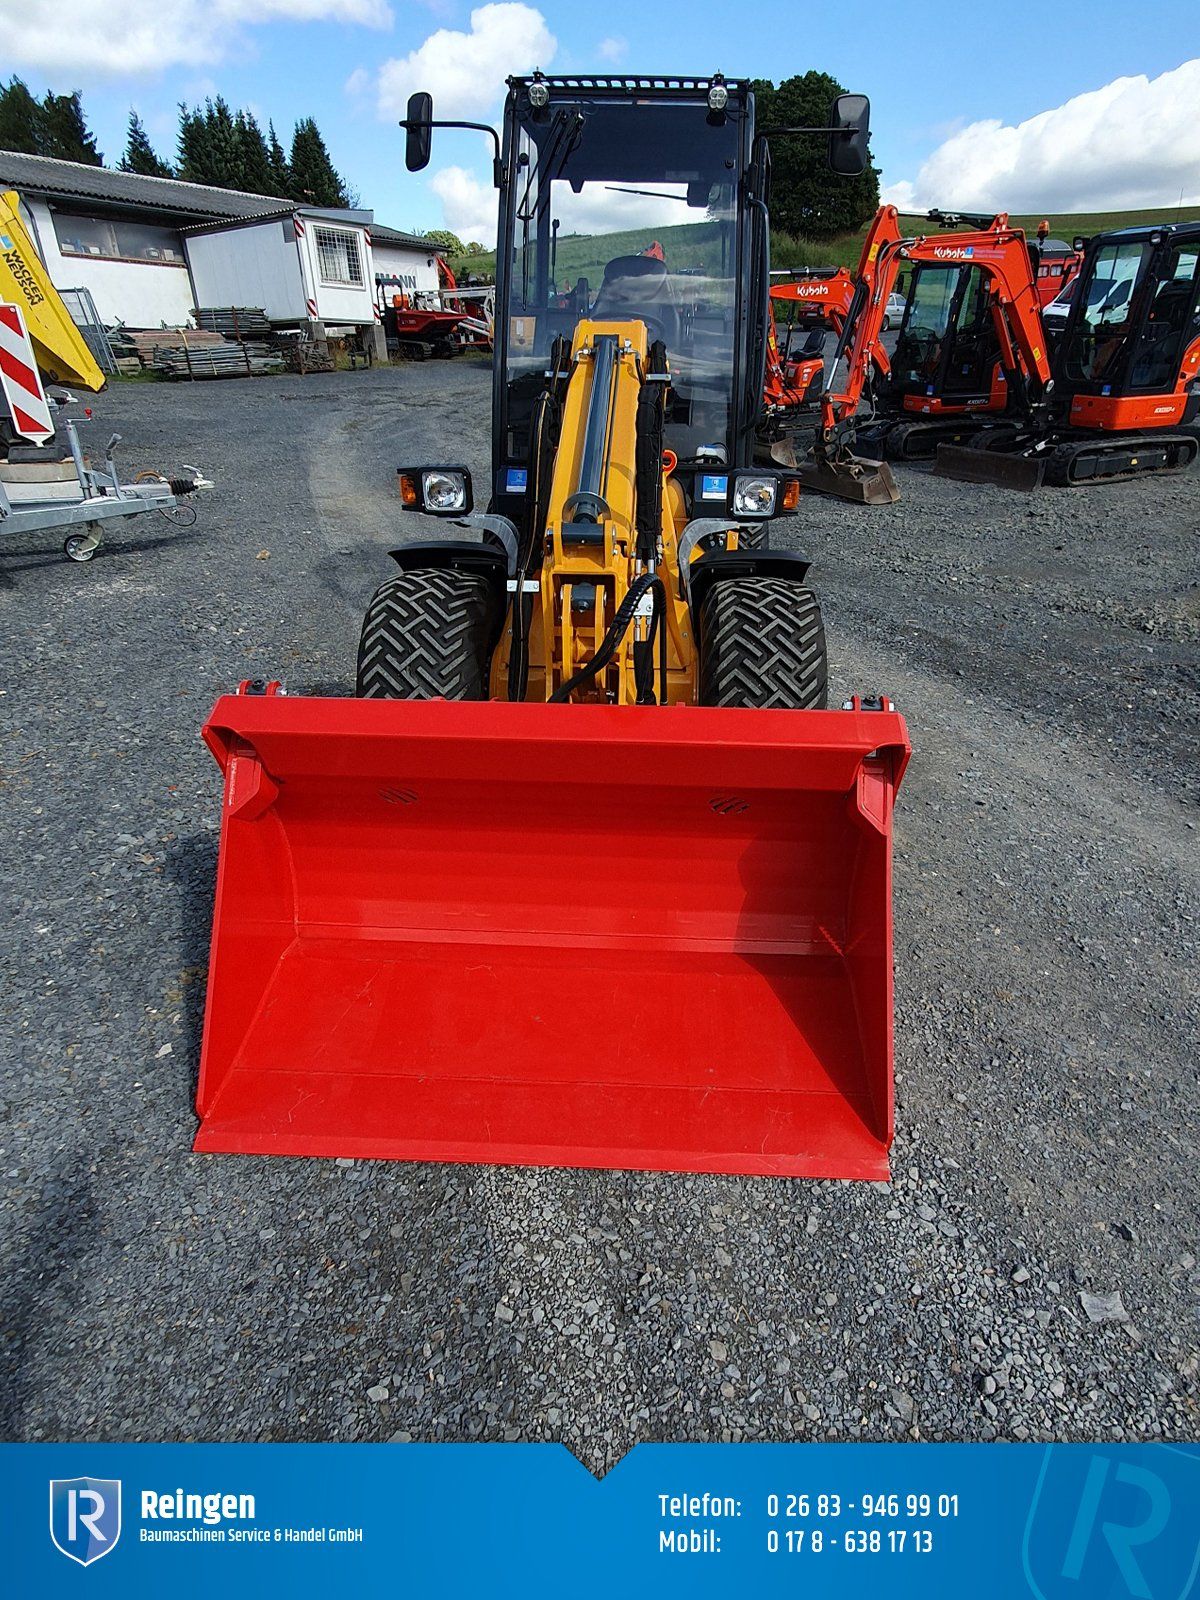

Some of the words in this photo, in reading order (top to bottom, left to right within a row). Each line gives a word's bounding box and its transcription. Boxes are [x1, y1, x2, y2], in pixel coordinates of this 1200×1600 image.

[934, 246, 966, 259] Kubota
[2, 252, 38, 306] NEUSON
[11, 249, 45, 303] WACKER
[797, 284, 829, 297] Kubota
